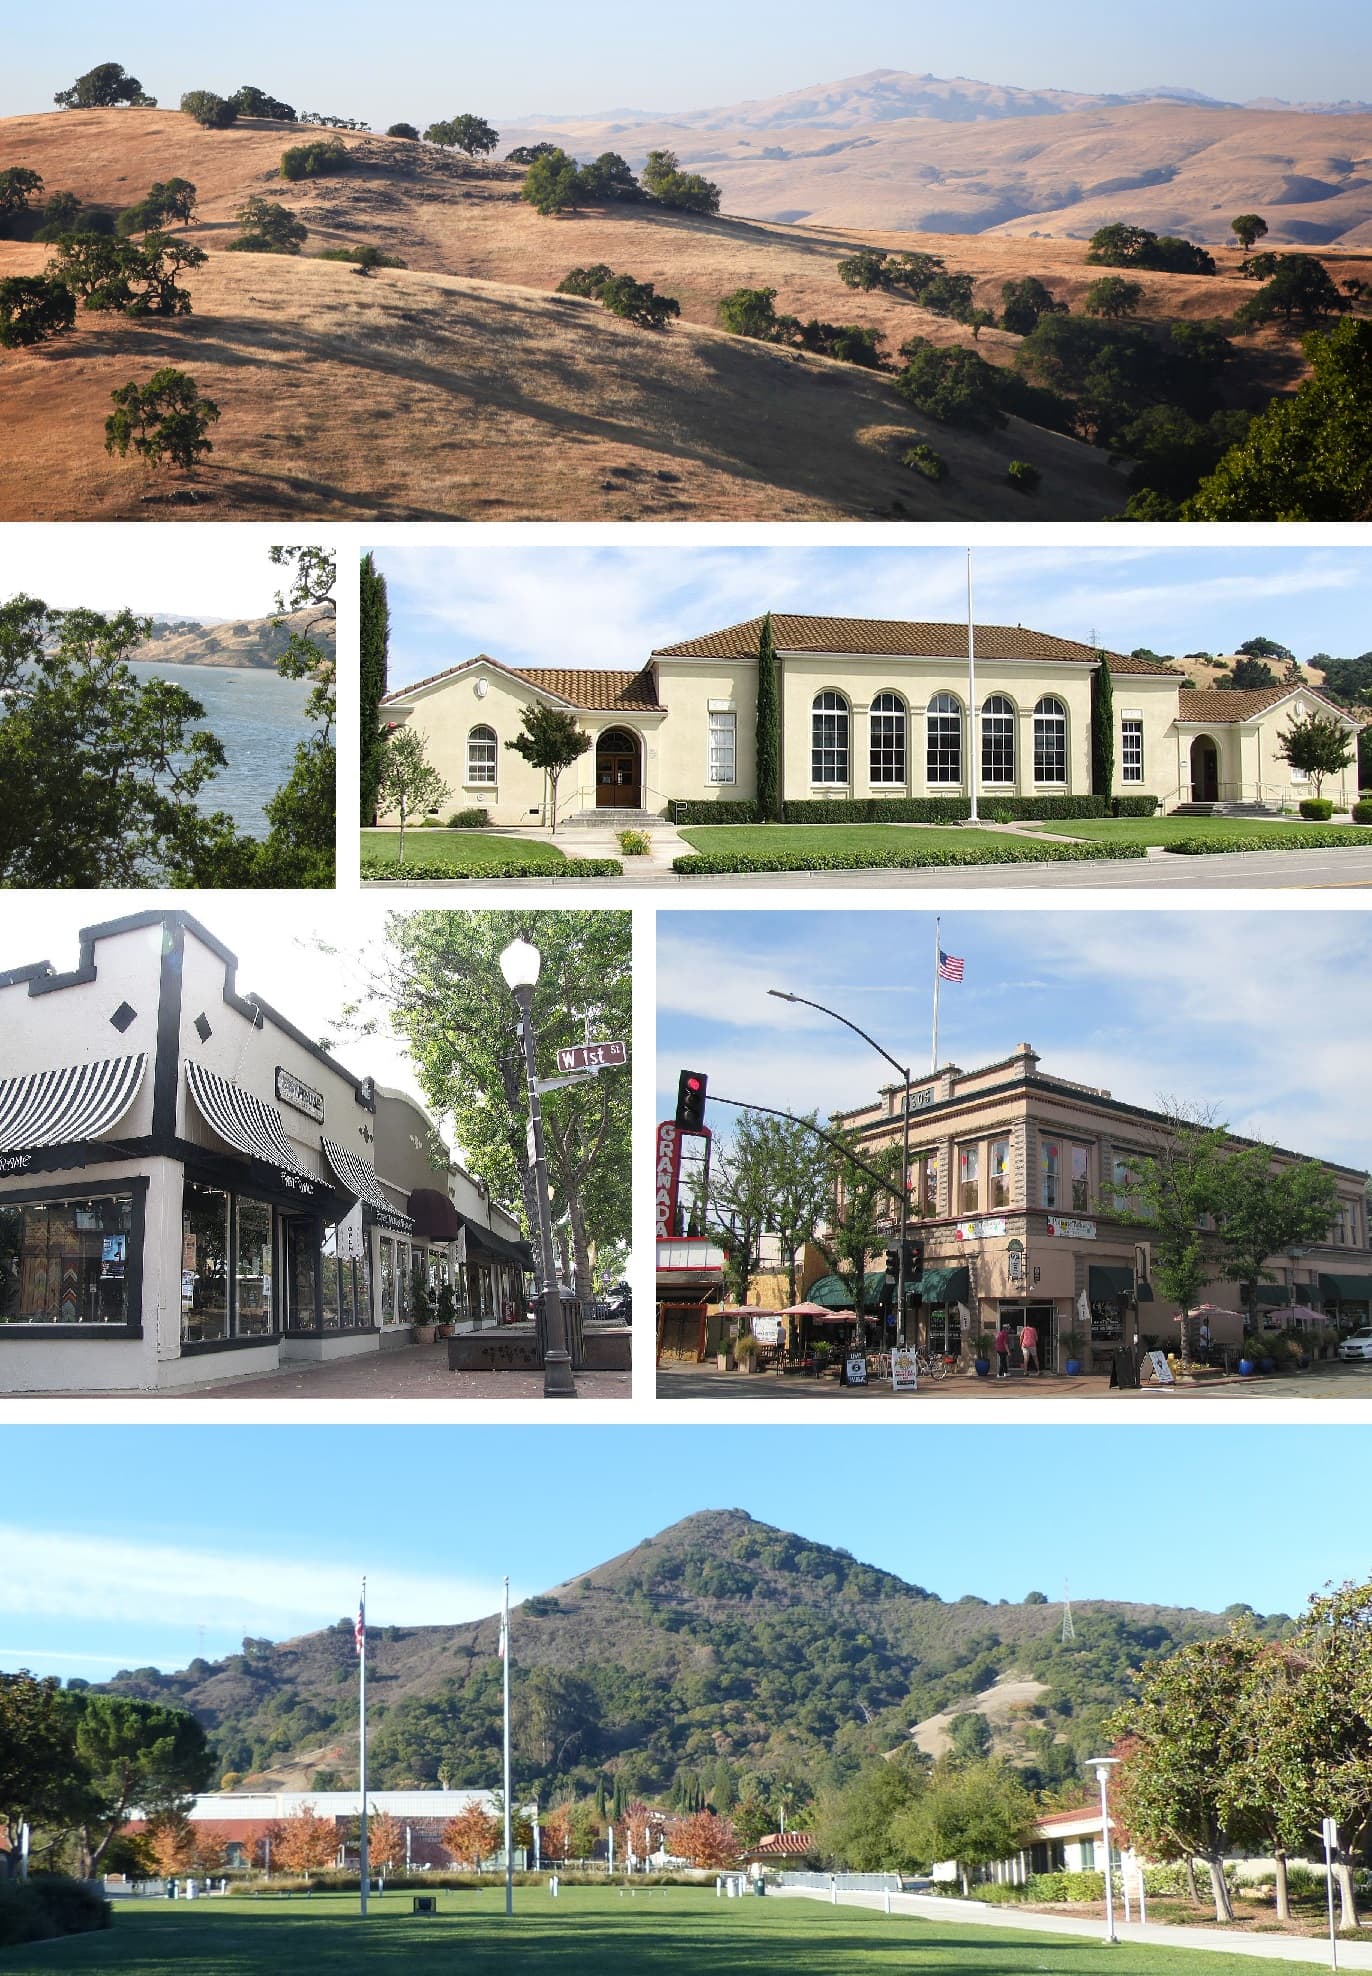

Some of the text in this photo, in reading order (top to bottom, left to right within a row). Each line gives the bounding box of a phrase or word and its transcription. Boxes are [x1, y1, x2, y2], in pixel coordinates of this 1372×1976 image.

[561, 1045, 621, 1069] W 1st St
[656, 1124, 676, 1237] GRANADA
